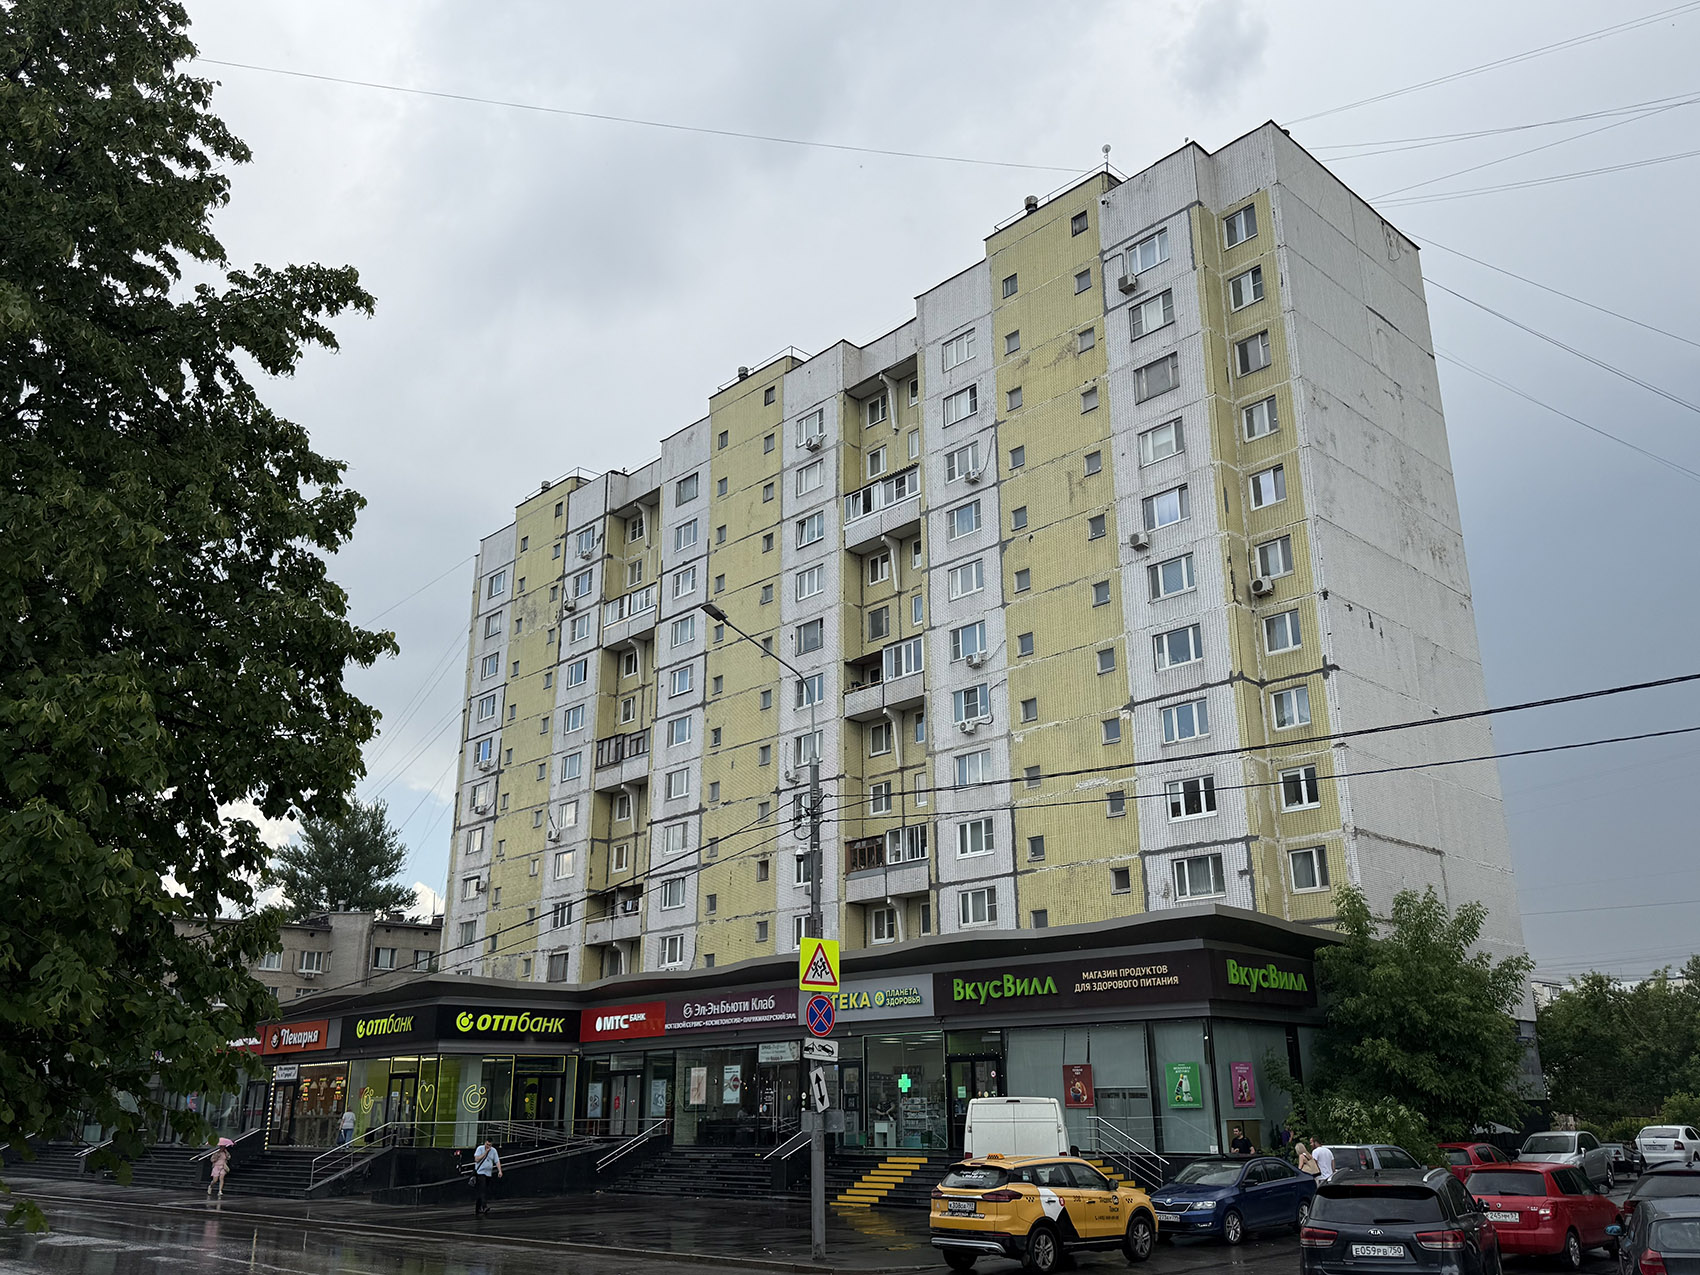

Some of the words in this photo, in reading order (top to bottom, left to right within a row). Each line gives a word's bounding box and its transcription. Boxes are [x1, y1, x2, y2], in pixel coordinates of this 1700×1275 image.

[1082, 969, 1118, 980] МАГАЗИН
[1119, 964, 1168, 977] ПРОДУКТОВ
[1226, 959, 1308, 992] ВкусВилл
[885, 987, 919, 997] ПЛАНЕТА
[953, 974, 1058, 1004] ВкусВилл
[1074, 983, 1091, 993] ДЛЯ
[1092, 978, 1138, 991] ЗДОРОВОГО
[1140, 975, 1179, 986] ПИТАНИЯ
[751, 995, 775, 1011] Клаб
[830, 991, 872, 1010] ТЕКА
[885, 995, 922, 1006] ЗДОРОВЬЯ
[603, 1014, 630, 1031] МТС
[629, 1013, 646, 1022] БАНК
[281, 1028, 320, 1047] Пекарня
